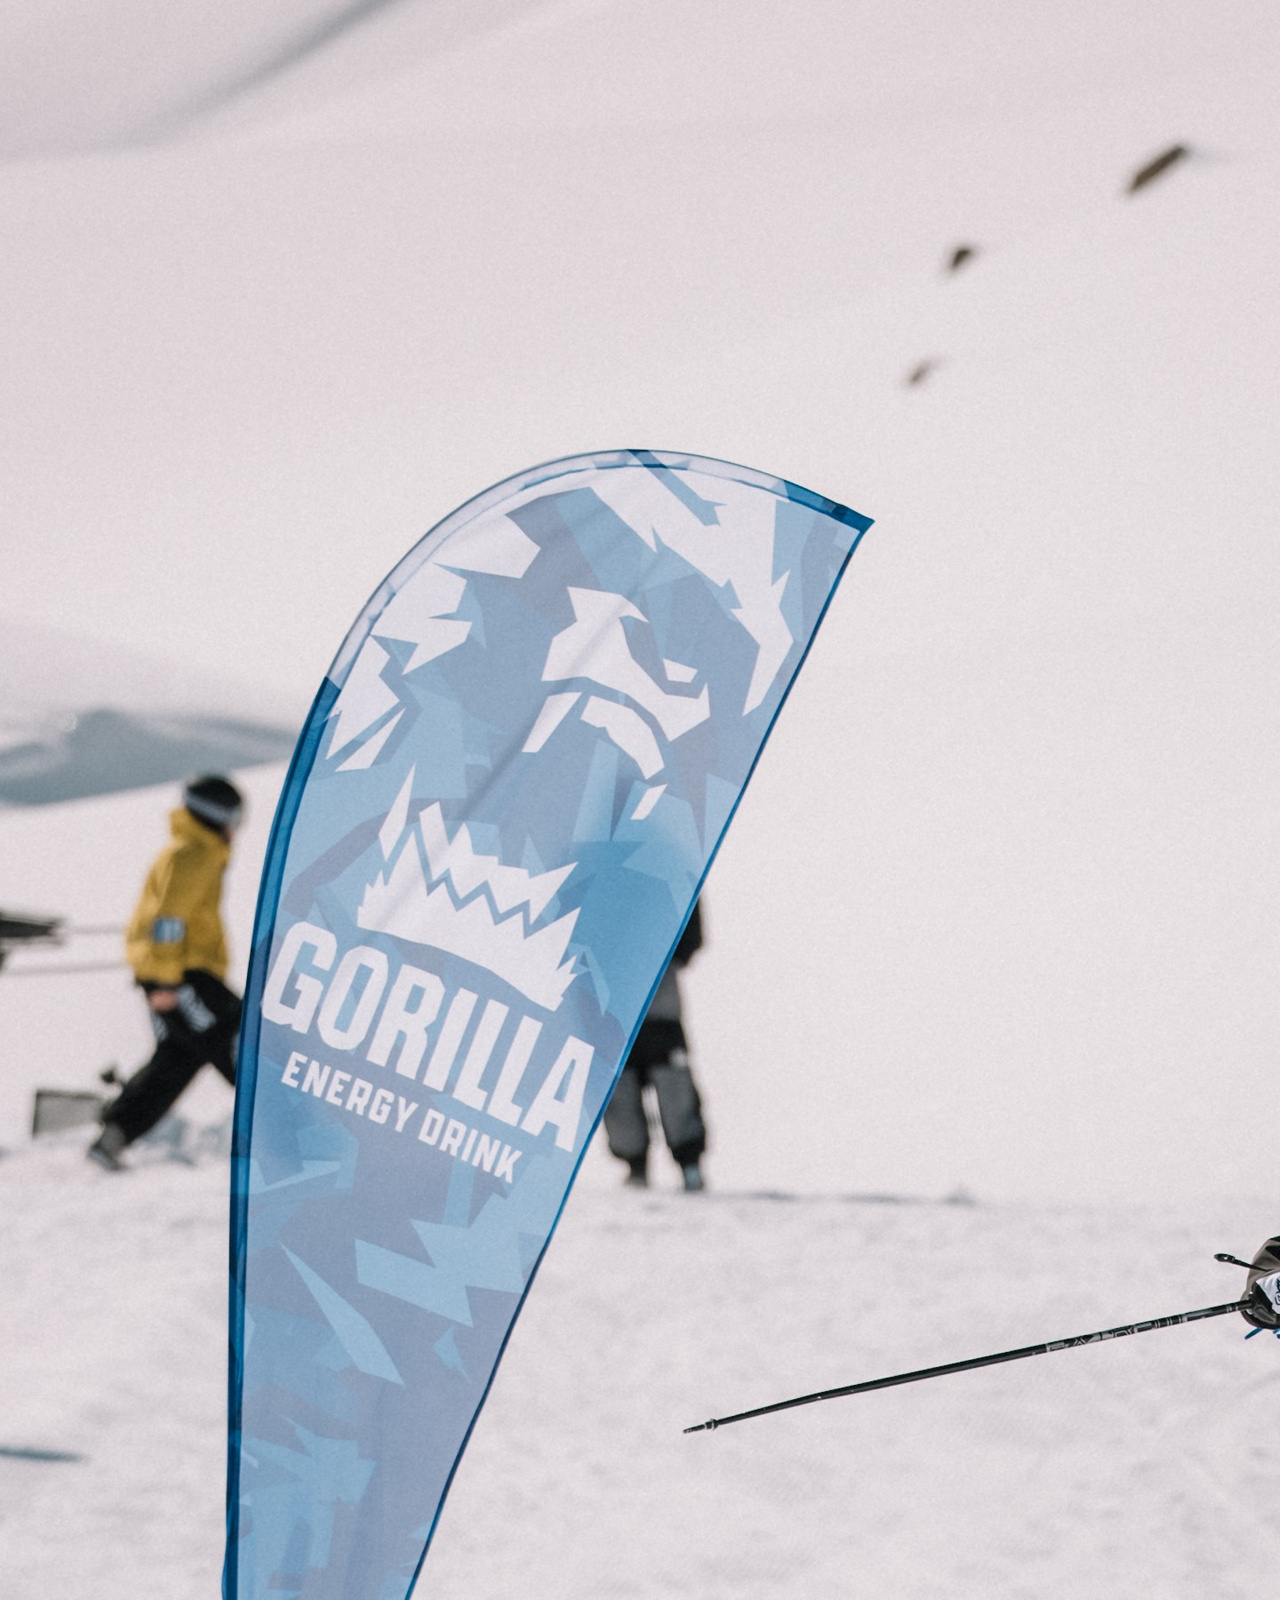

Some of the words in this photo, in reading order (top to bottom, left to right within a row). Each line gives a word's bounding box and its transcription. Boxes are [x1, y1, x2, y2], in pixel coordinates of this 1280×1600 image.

[262, 921, 595, 1153] GORILLA
[281, 1050, 420, 1133] ENERGY
[417, 1108, 522, 1184] DRINK
